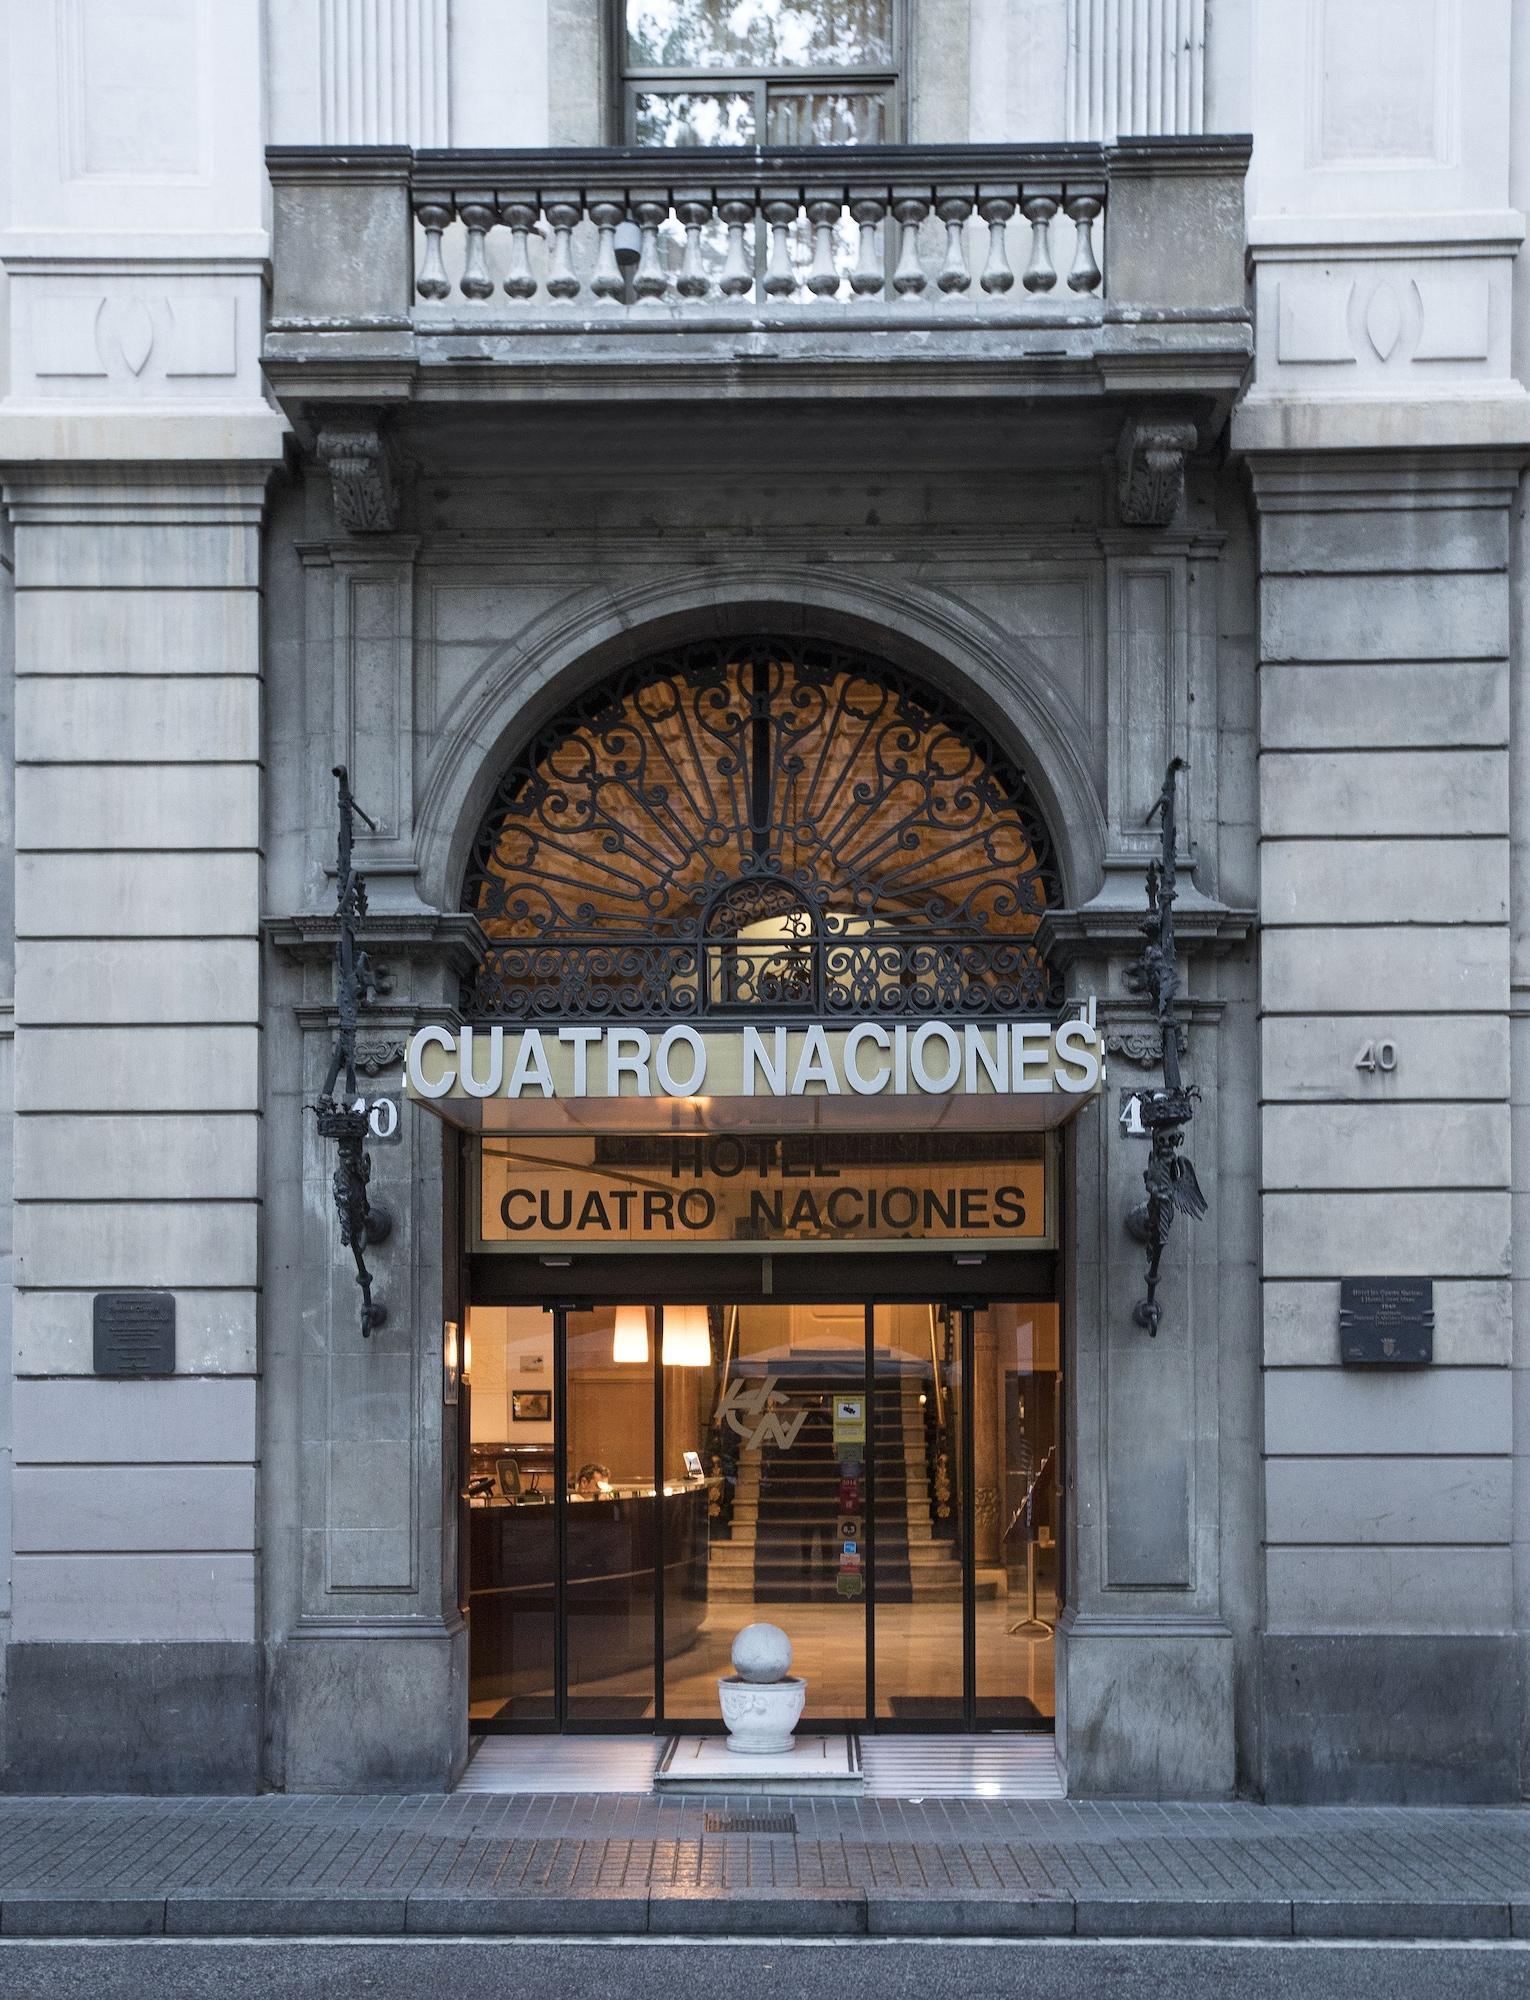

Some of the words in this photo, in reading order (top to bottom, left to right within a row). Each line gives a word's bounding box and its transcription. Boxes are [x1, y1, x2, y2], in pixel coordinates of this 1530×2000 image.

[408, 1024, 708, 1099] CUATRO
[742, 1020, 1100, 1097] NACIONES
[1353, 1040, 1398, 1072] 40
[671, 1134, 841, 1179] HOTEL
[499, 1189, 716, 1232] CUATRO
[749, 1187, 1027, 1230] NACIONES
